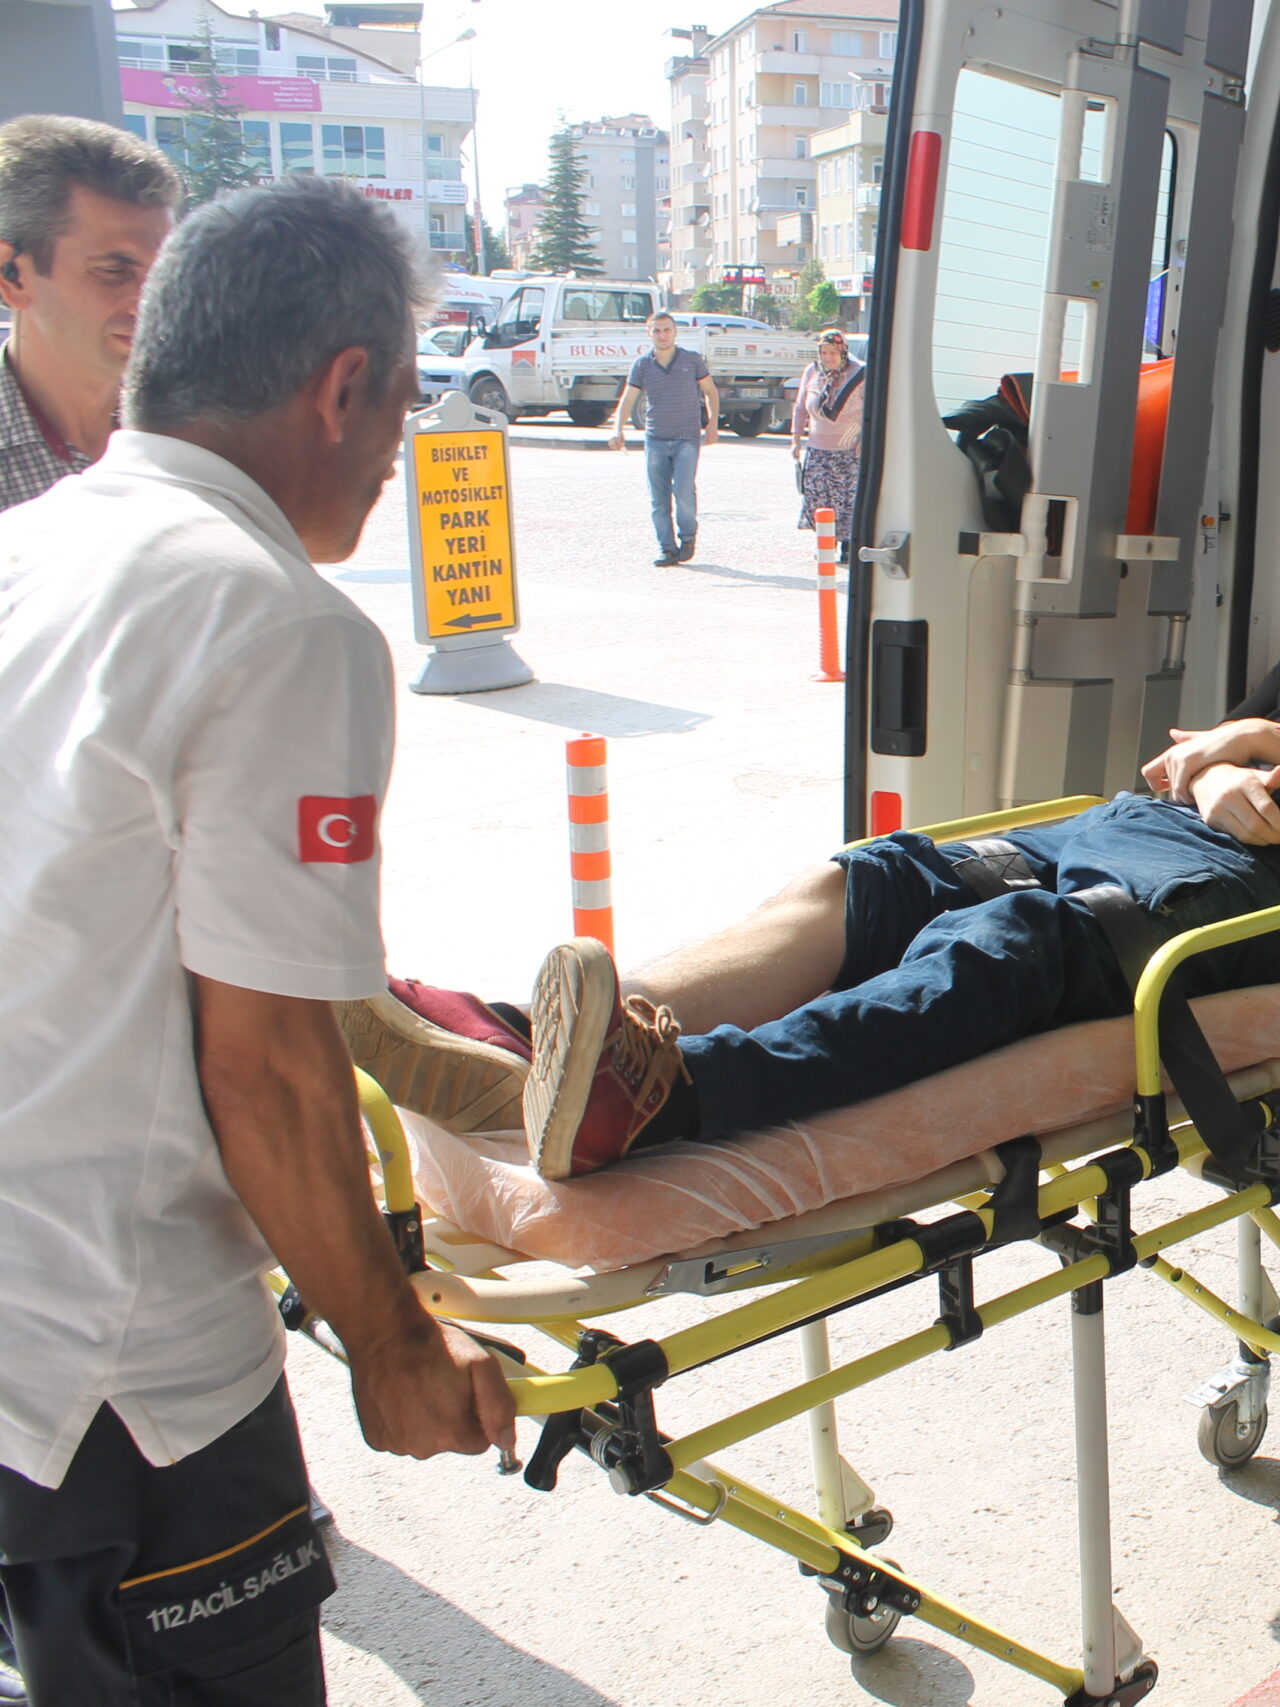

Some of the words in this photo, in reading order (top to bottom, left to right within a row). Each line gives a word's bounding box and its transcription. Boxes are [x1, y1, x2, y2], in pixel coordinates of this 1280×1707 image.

[569, 344, 628, 357] BURSA
[431, 442, 488, 462] BİSİKLET
[452, 467, 469, 482] VE
[422, 483, 503, 505] MOTOSİKLET
[440, 509, 490, 530] PARK
[444, 530, 486, 555] YERİ
[432, 555, 503, 582] KANTİN
[446, 585, 491, 606] YANI
[146, 1604, 186, 1632] 112
[187, 1581, 244, 1623] ACİL
[243, 1539, 321, 1599] SAĞLIK
